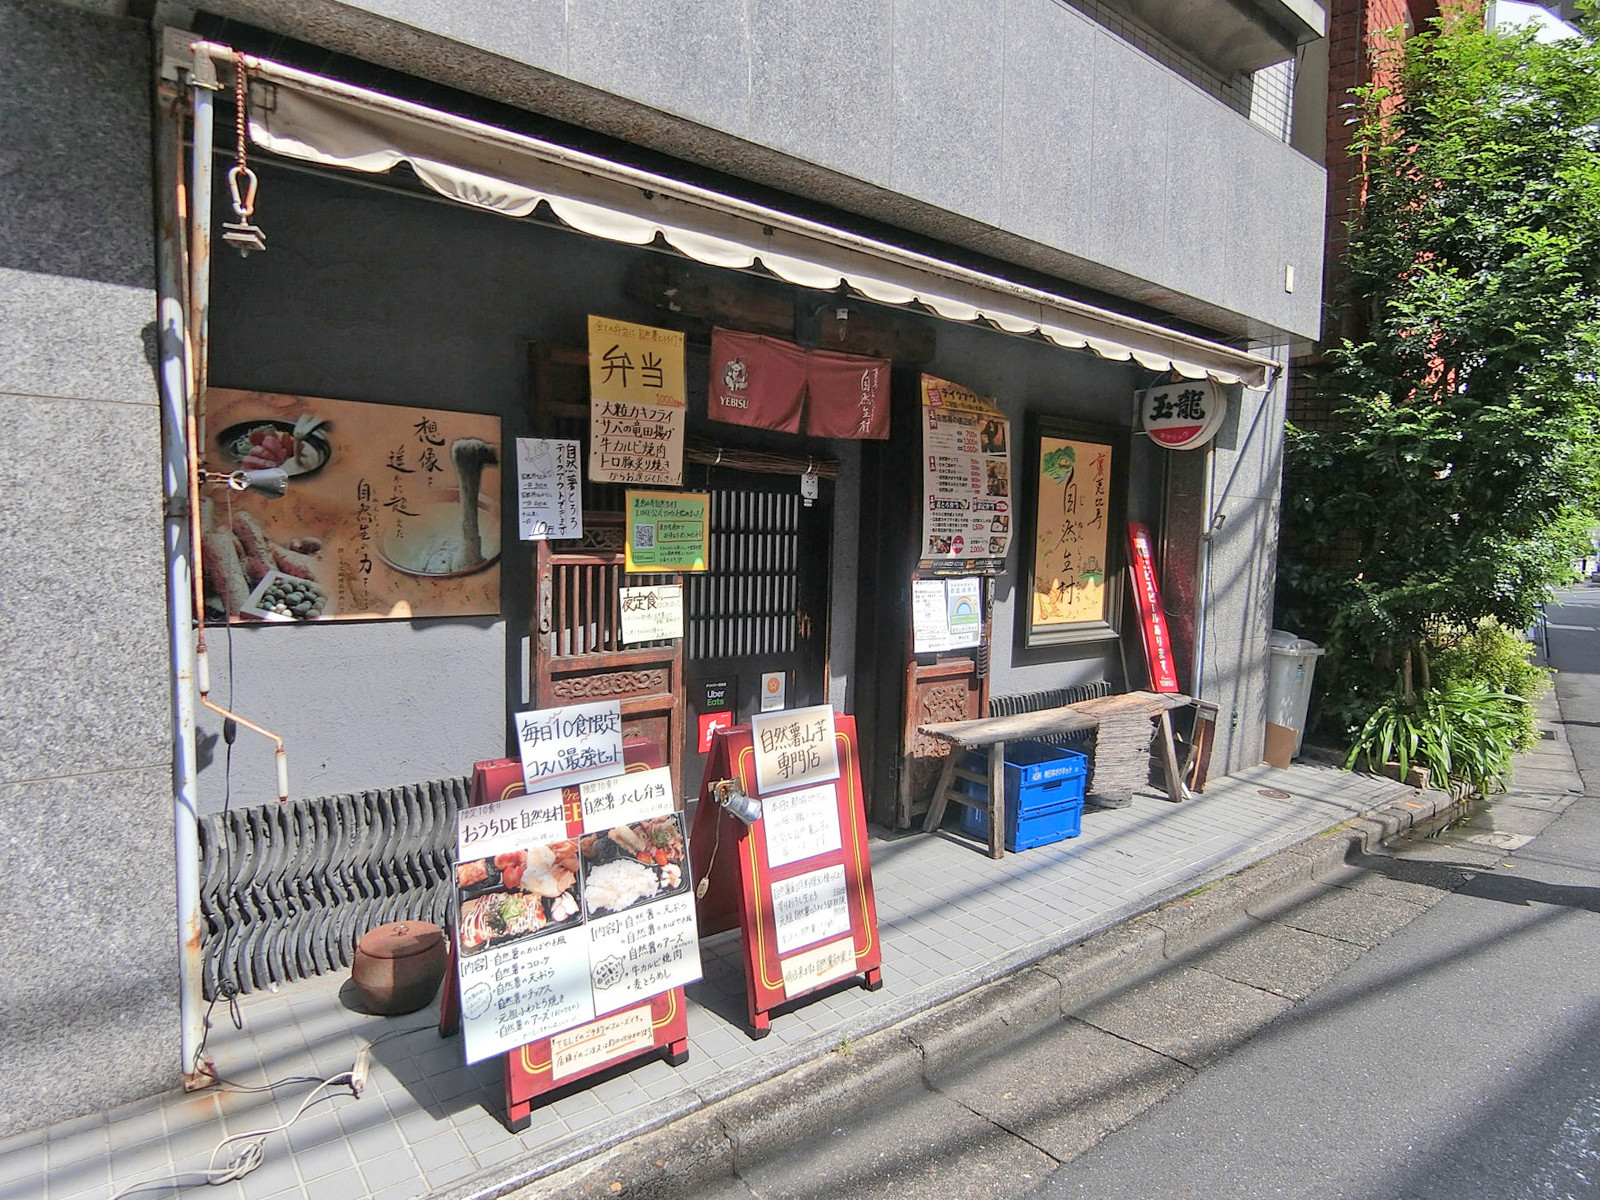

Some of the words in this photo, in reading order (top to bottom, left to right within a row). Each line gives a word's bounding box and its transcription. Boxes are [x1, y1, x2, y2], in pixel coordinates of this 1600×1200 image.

[601, 344, 663, 388] 弁当
[601, 401, 673, 422] 大粒カキフライ
[720, 395, 749, 409] YEBISU
[1149, 389, 1206, 421] 玉龍
[601, 418, 676, 440] サバの竜田揚げ
[413, 415, 445, 487] 想像を
[600, 437, 666, 459] 牛カルビ焼肉
[600, 454, 670, 473] トロ豚炙り焼き
[564, 443, 578, 530] 自然薯とろろ
[1054, 466, 1077, 605] 自然生村
[622, 588, 659, 612] 夜定食
[706, 698, 725, 707] Eats
[707, 690, 726, 699] Uber
[521, 709, 620, 748] 毎日10食限定
[760, 719, 827, 754] 自然薯山芋
[526, 743, 622, 779] コスパ最強セット
[776, 744, 821, 779] 専門店
[584, 783, 666, 815] 自然薯づくし弁当
[462, 804, 563, 843] おうちDE自然生村
[632, 949, 682, 976] 牛カルビ焼肉
[497, 967, 555, 996] 自然薯の天ぷら
[634, 969, 671, 991] 麦とろめし
[498, 984, 552, 1010] 自然薯のチップス
[499, 994, 564, 1024] 元祖ふわとろ焼き
